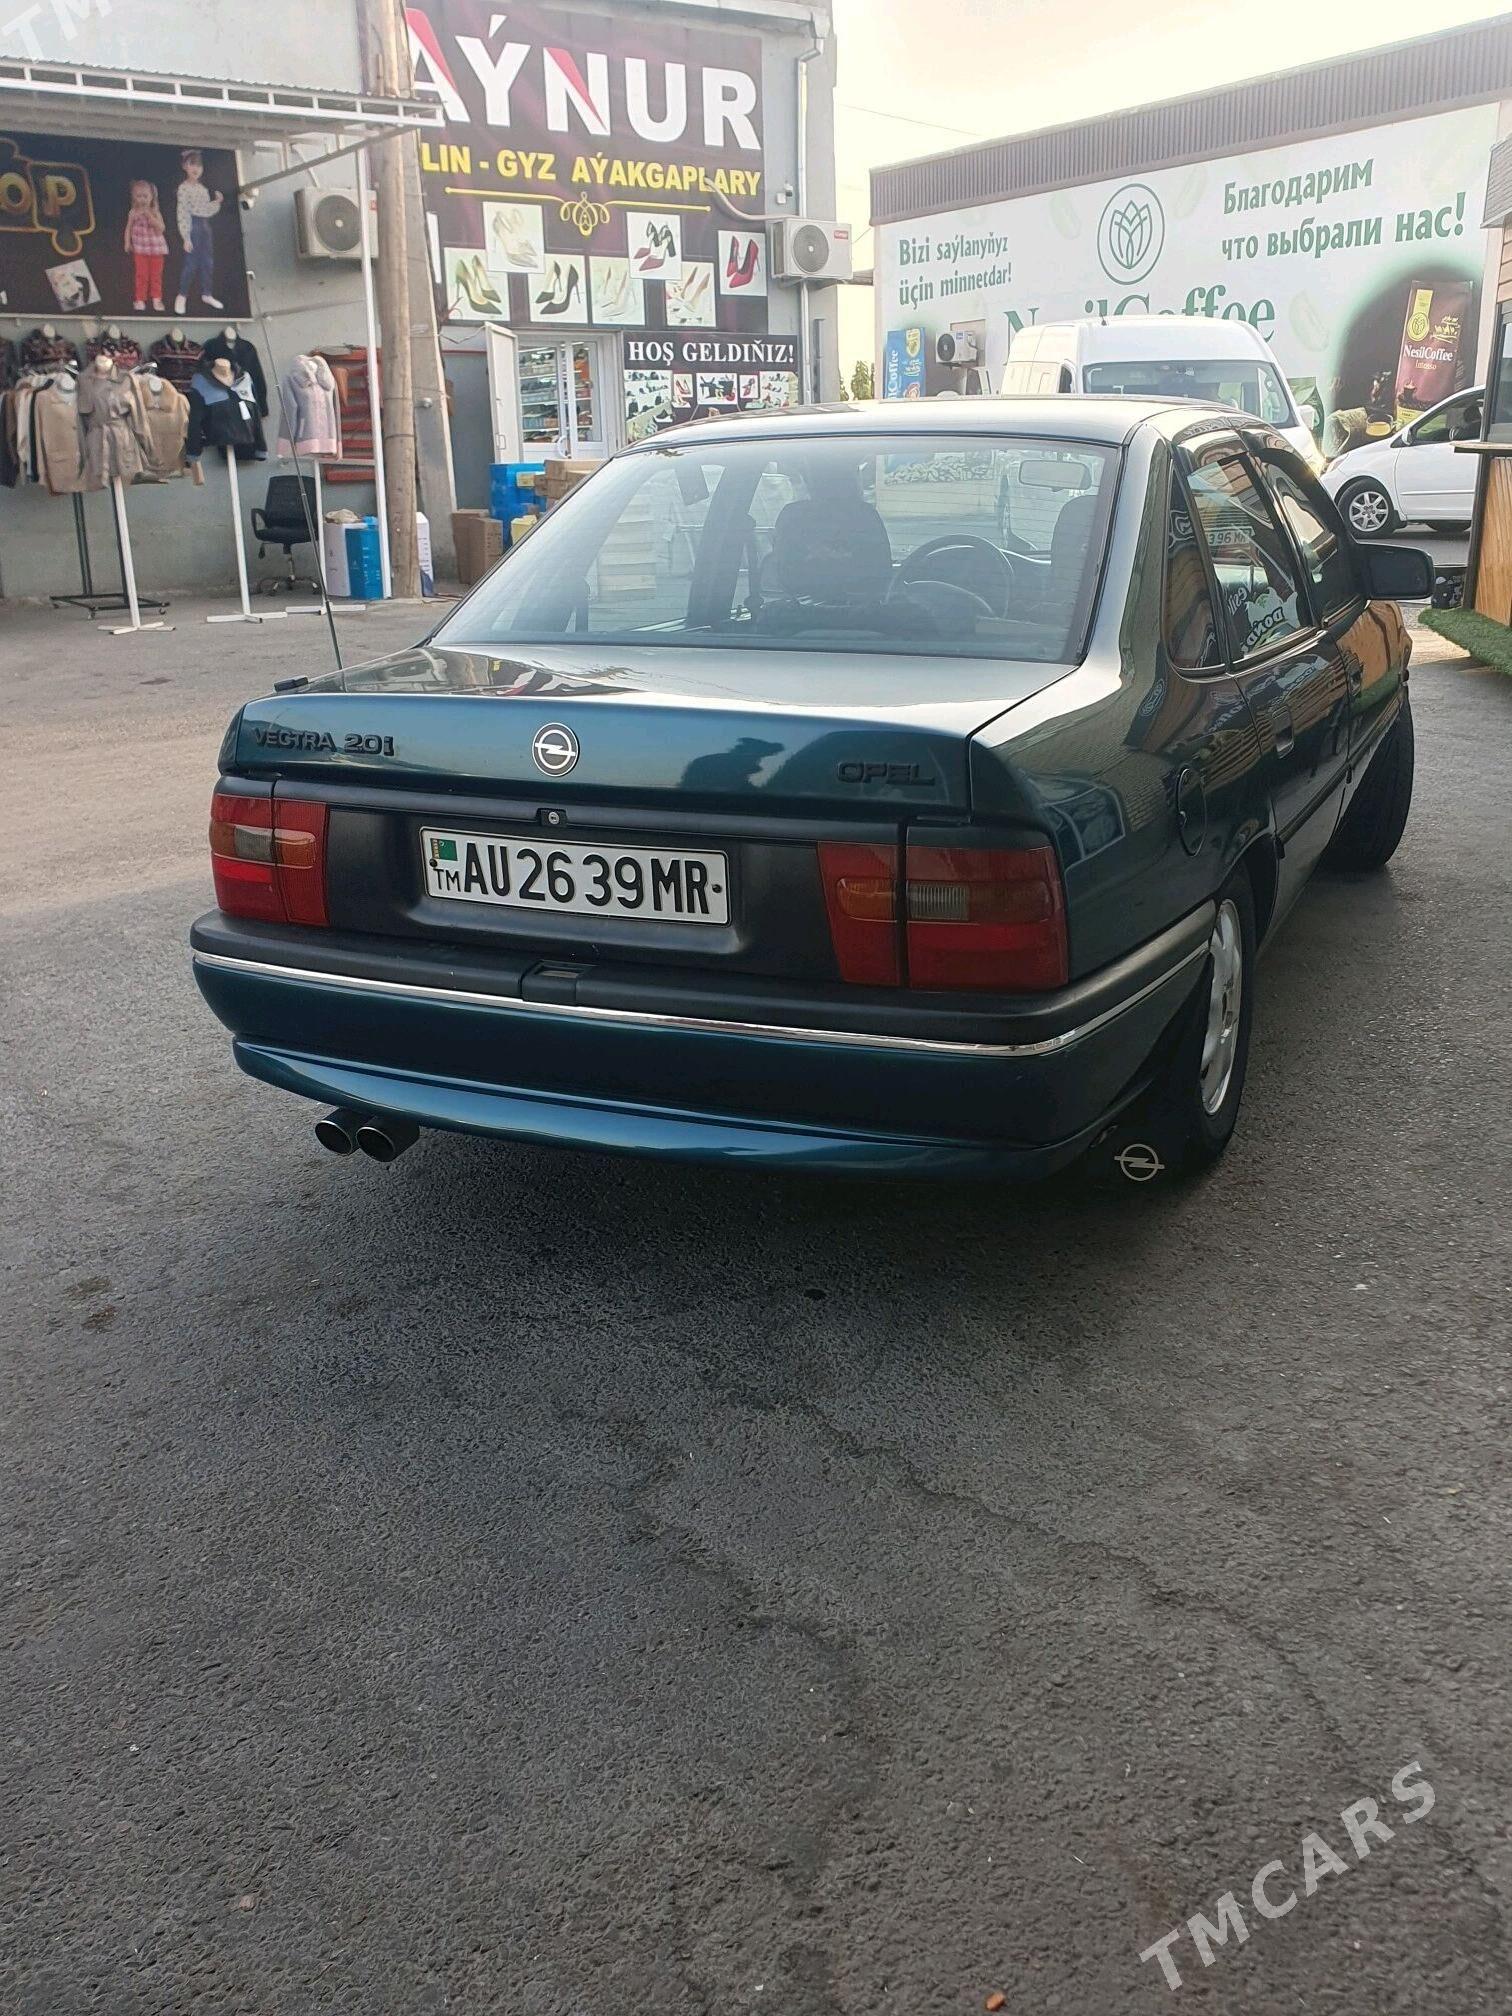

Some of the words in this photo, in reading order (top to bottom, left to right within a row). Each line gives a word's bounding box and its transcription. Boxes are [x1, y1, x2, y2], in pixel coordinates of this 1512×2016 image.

[404, 8, 761, 151] AÝNUR
[497, 149, 556, 181] GYZ
[572, 152, 762, 196] AÝAKGAPLARY
[1224, 158, 1374, 214] Благодарим
[1222, 234, 1259, 261] что
[1267, 217, 1383, 259] выбрали
[1395, 191, 1466, 243] нас!
[899, 236, 930, 266] Bizi
[936, 231, 1009, 264] saýlanyňyz
[899, 275, 934, 310] üçin
[940, 262, 1012, 297] minnetdar!
[628, 341, 674, 366] HOŞ
[682, 340, 794, 363] GELDIŇIZ!
[254, 727, 338, 752] VECTRA
[837, 762, 936, 786] OPEL
[433, 868, 461, 892] TM
